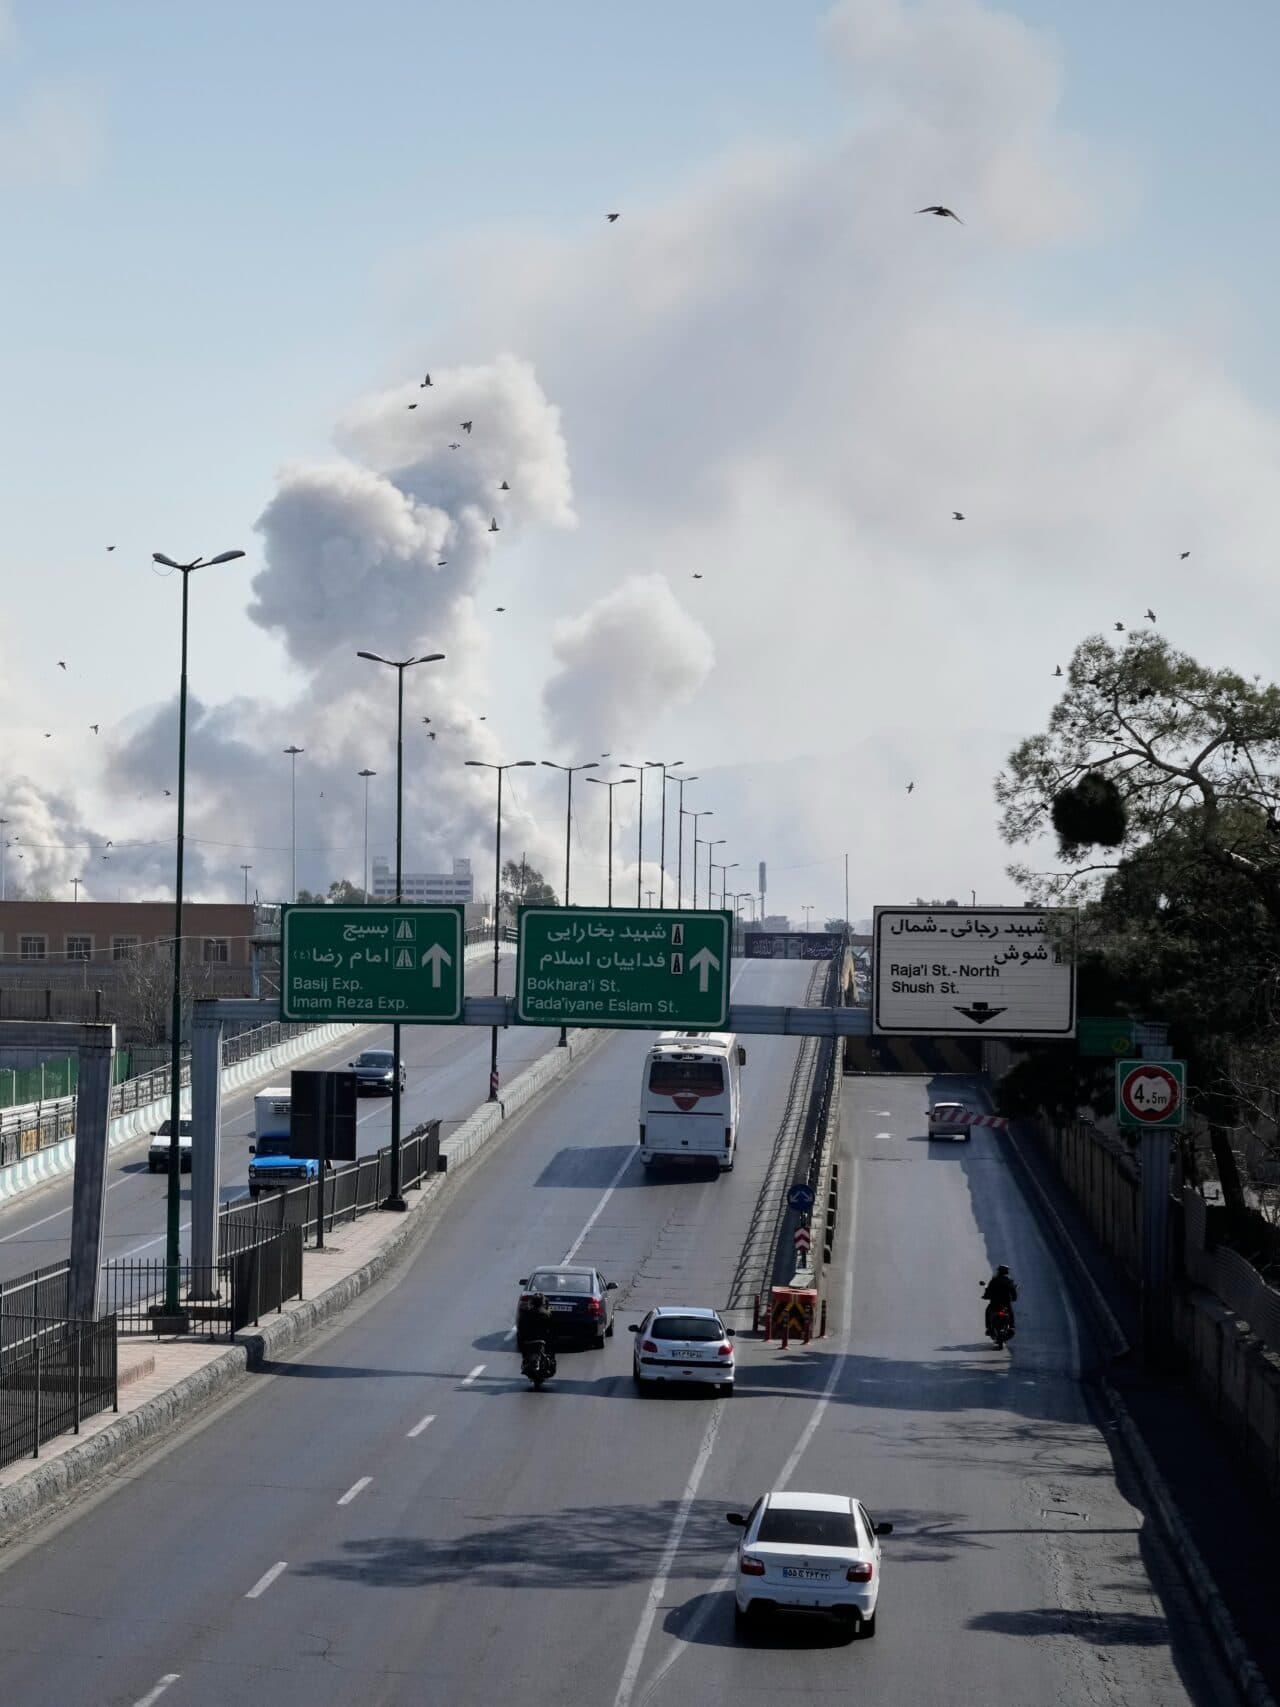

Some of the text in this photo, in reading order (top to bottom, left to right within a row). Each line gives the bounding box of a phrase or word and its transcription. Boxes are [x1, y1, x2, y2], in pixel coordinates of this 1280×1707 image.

[342, 923, 389, 941] بسیج
[547, 922, 667, 943] شهید بخارایی
[891, 916, 937, 935] شمال
[349, 948, 389, 968] امام
[540, 950, 590, 971] اسلام
[994, 944, 1048, 966] شوش
[293, 977, 364, 992] Basij Exp.
[527, 977, 620, 993] Bokhara'i St.
[891, 981, 960, 995] Shush St.
[293, 996, 409, 1011] Imam Reza Exp.
[527, 996, 679, 1014] Fada'iyane Eslam St.
